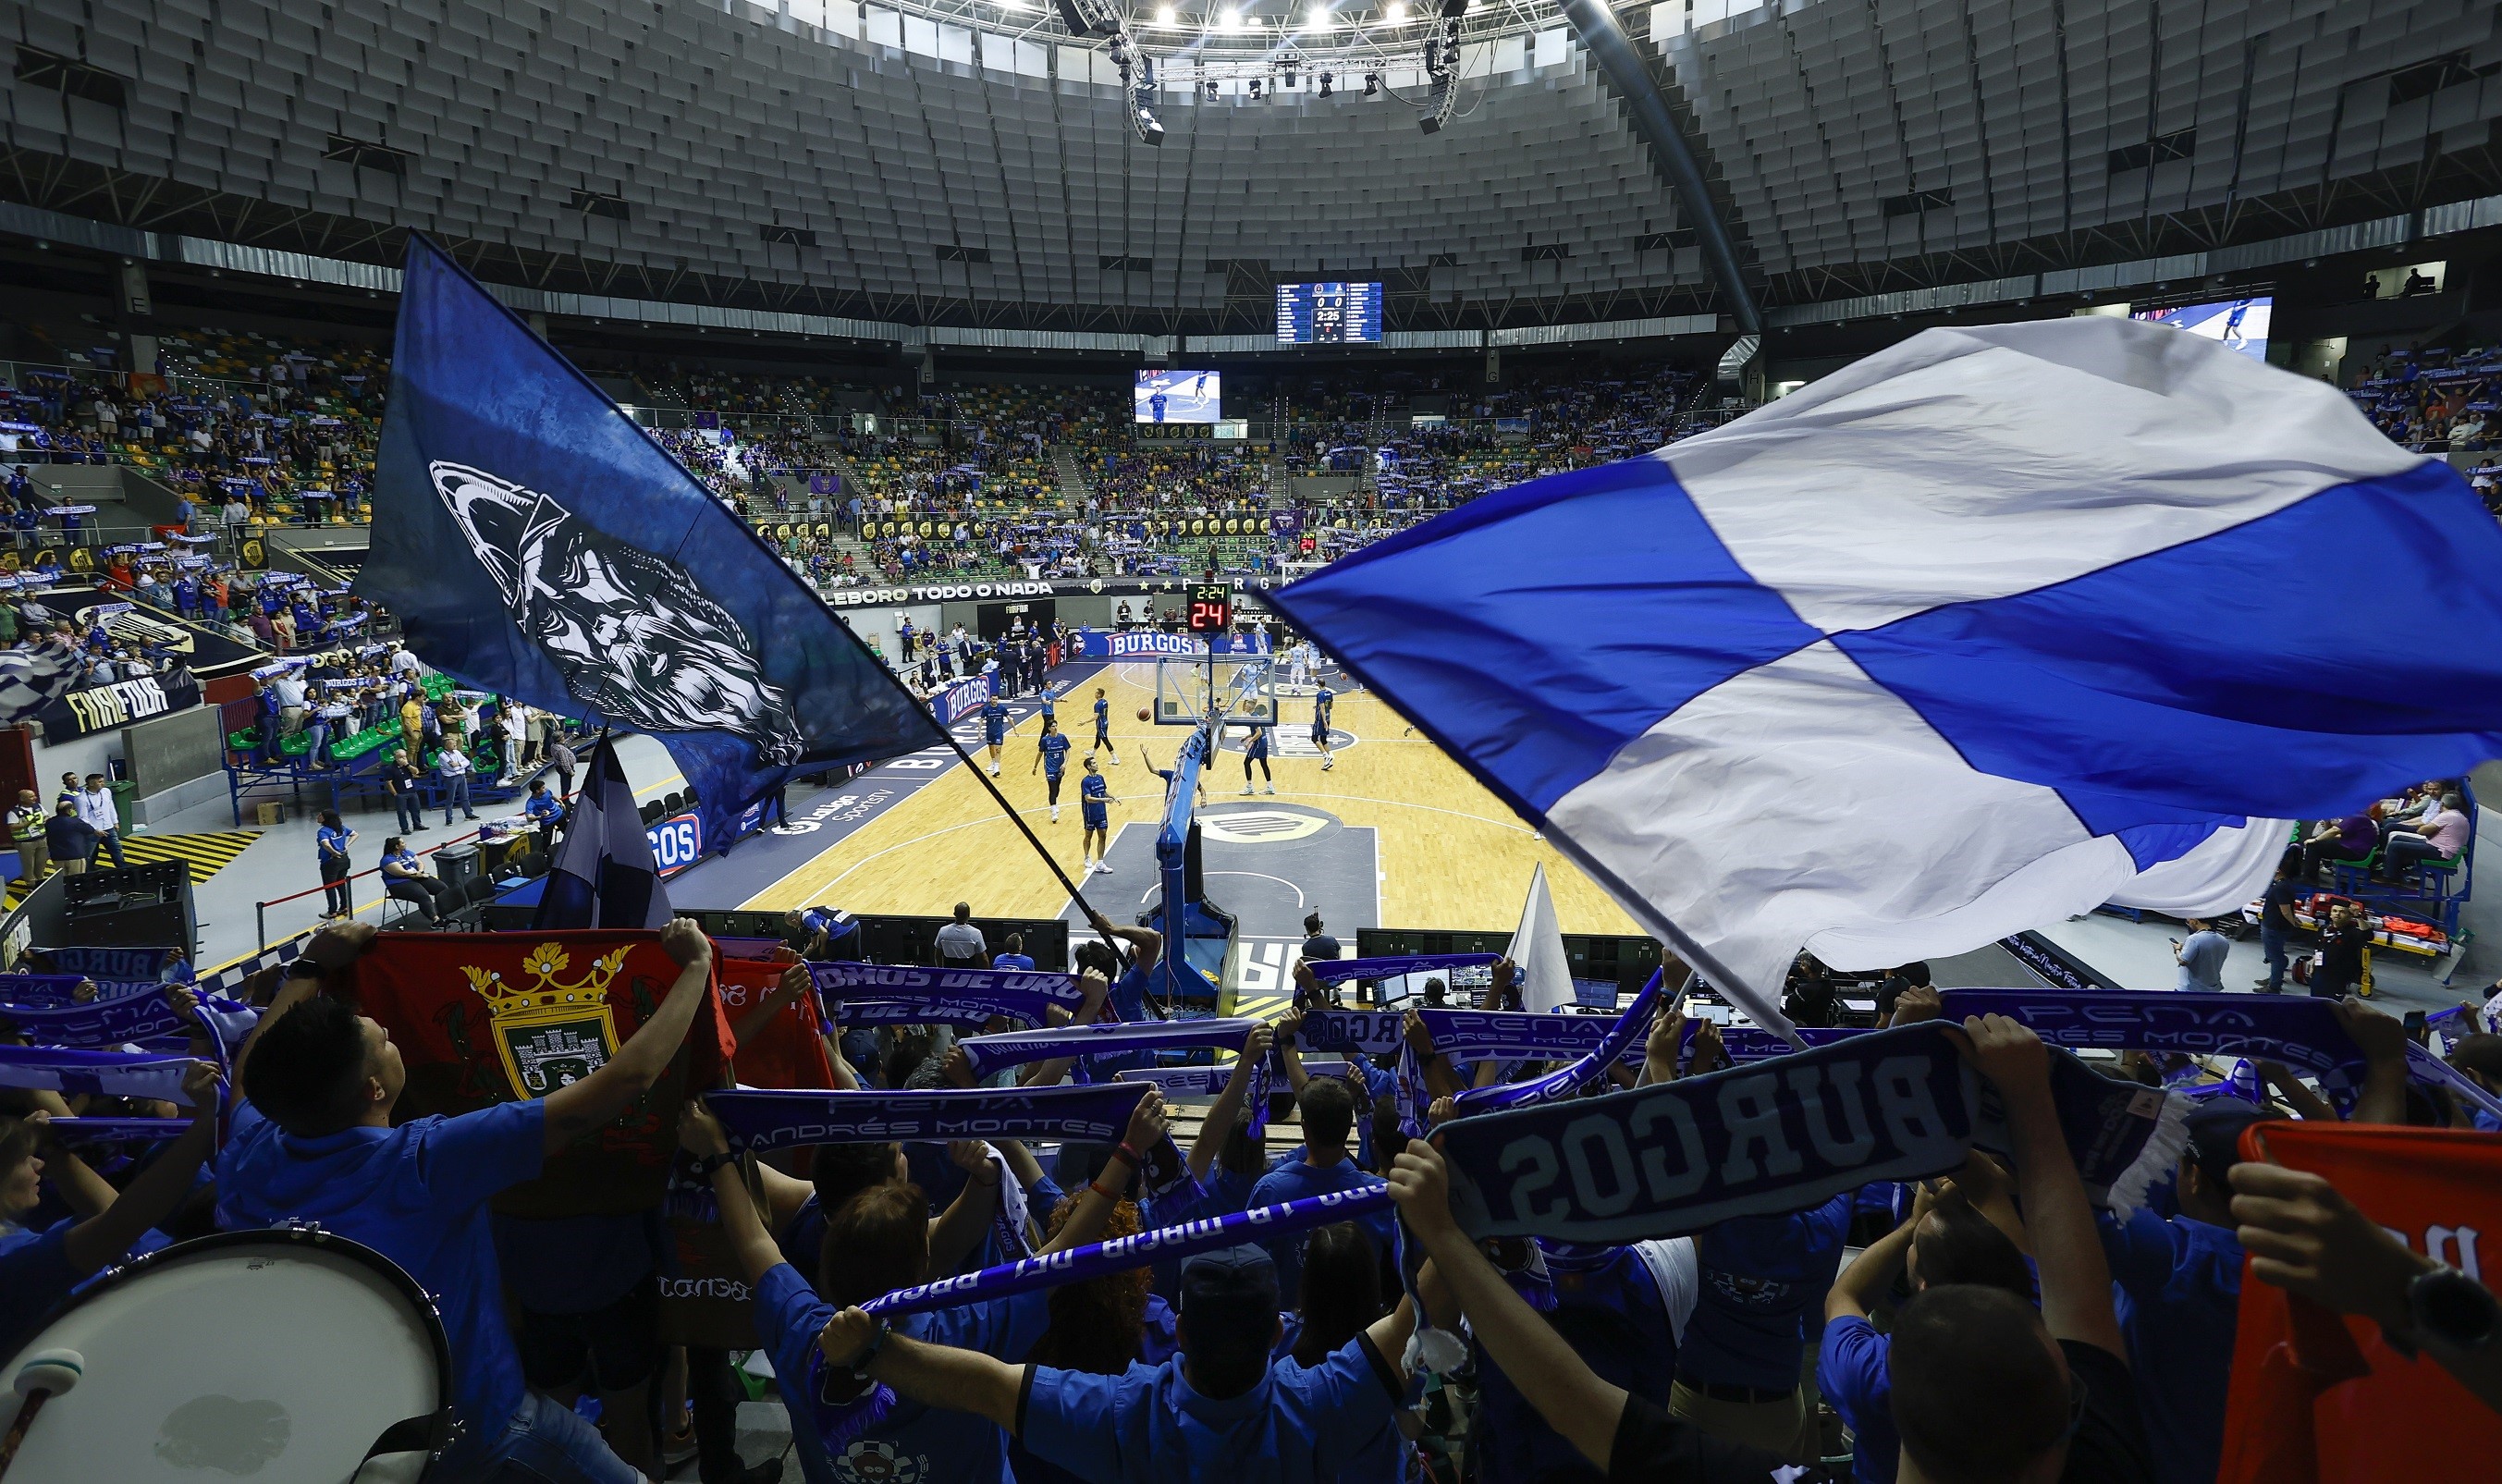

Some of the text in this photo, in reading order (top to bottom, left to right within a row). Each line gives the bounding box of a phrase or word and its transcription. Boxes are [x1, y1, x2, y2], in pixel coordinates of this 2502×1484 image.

[131, 297, 147, 313] E
[1318, 297, 1343, 307] 0 0
[1317, 311, 1340, 321] 2:25
[925, 372, 931, 383] F
[1749, 374, 1759, 384] H
[114, 545, 137, 553] BURGOS
[1301, 539, 1314, 549] 24
[25, 572, 54, 583] BURGOS
[912, 584, 972, 600] TODO
[976, 583, 992, 596] O
[997, 582, 1054, 596] NADA
[1196, 586, 1225, 599] 2:24
[1192, 603, 1222, 628] 24
[1113, 632, 1193, 655] BURGOS
[325, 678, 358, 687] BURGOS
[949, 679, 987, 718] BURGOS
[800, 795, 860, 820] LaLiga
[645, 822, 694, 870] GOS
[817, 967, 931, 988] OMOS
[751, 1115, 1115, 1147] ANDRÉS MONTES
